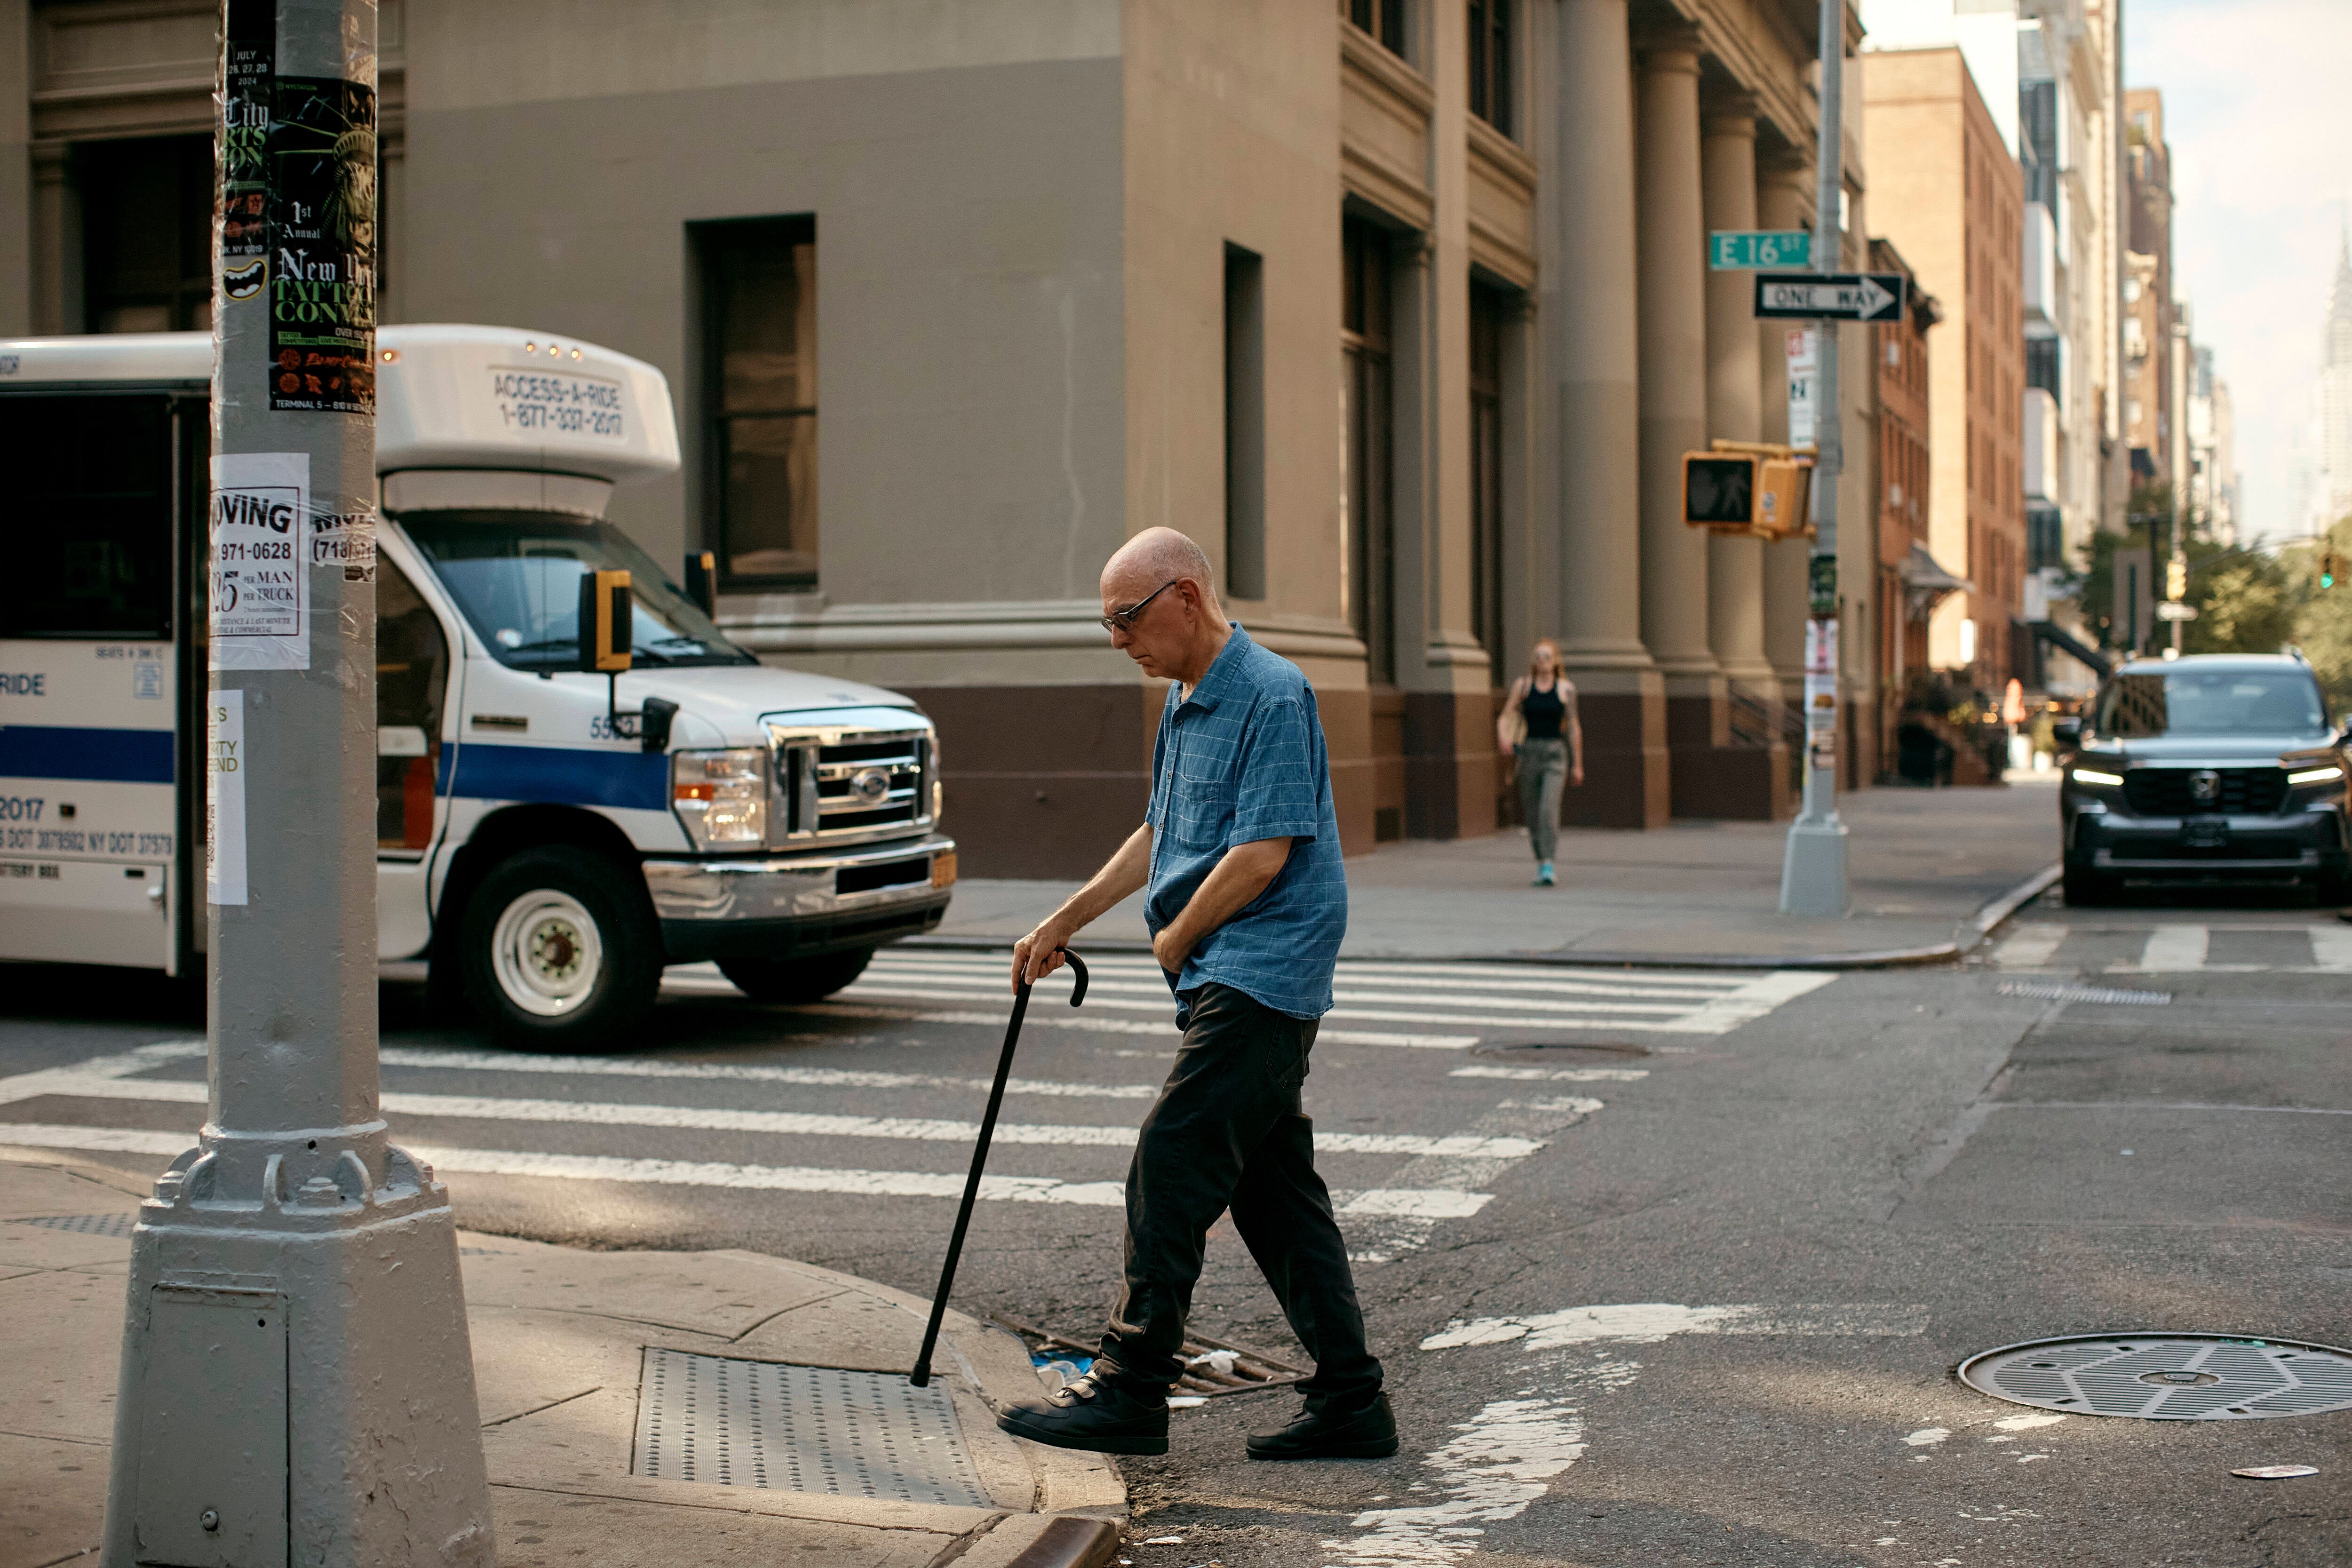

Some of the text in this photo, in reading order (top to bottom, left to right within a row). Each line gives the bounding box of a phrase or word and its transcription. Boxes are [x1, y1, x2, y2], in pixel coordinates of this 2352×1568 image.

[237, 50, 257, 60] JULY
[256, 64, 267, 73] 28
[224, 96, 269, 132] City
[291, 201, 311, 224] 1st
[283, 223, 320, 239] Annual
[1719, 236, 1801, 265] E 16 ST
[275, 247, 336, 282] New
[1837, 288, 1879, 309] WAY
[495, 374, 622, 411] ACCESS-A-RIDE
[276, 400, 315, 409] TERMINAL
[222, 542, 292, 561] 971-0628
[257, 571, 293, 584] MAN
[257, 588, 294, 601] TRUCK
[109, 831, 135, 854] DOT
